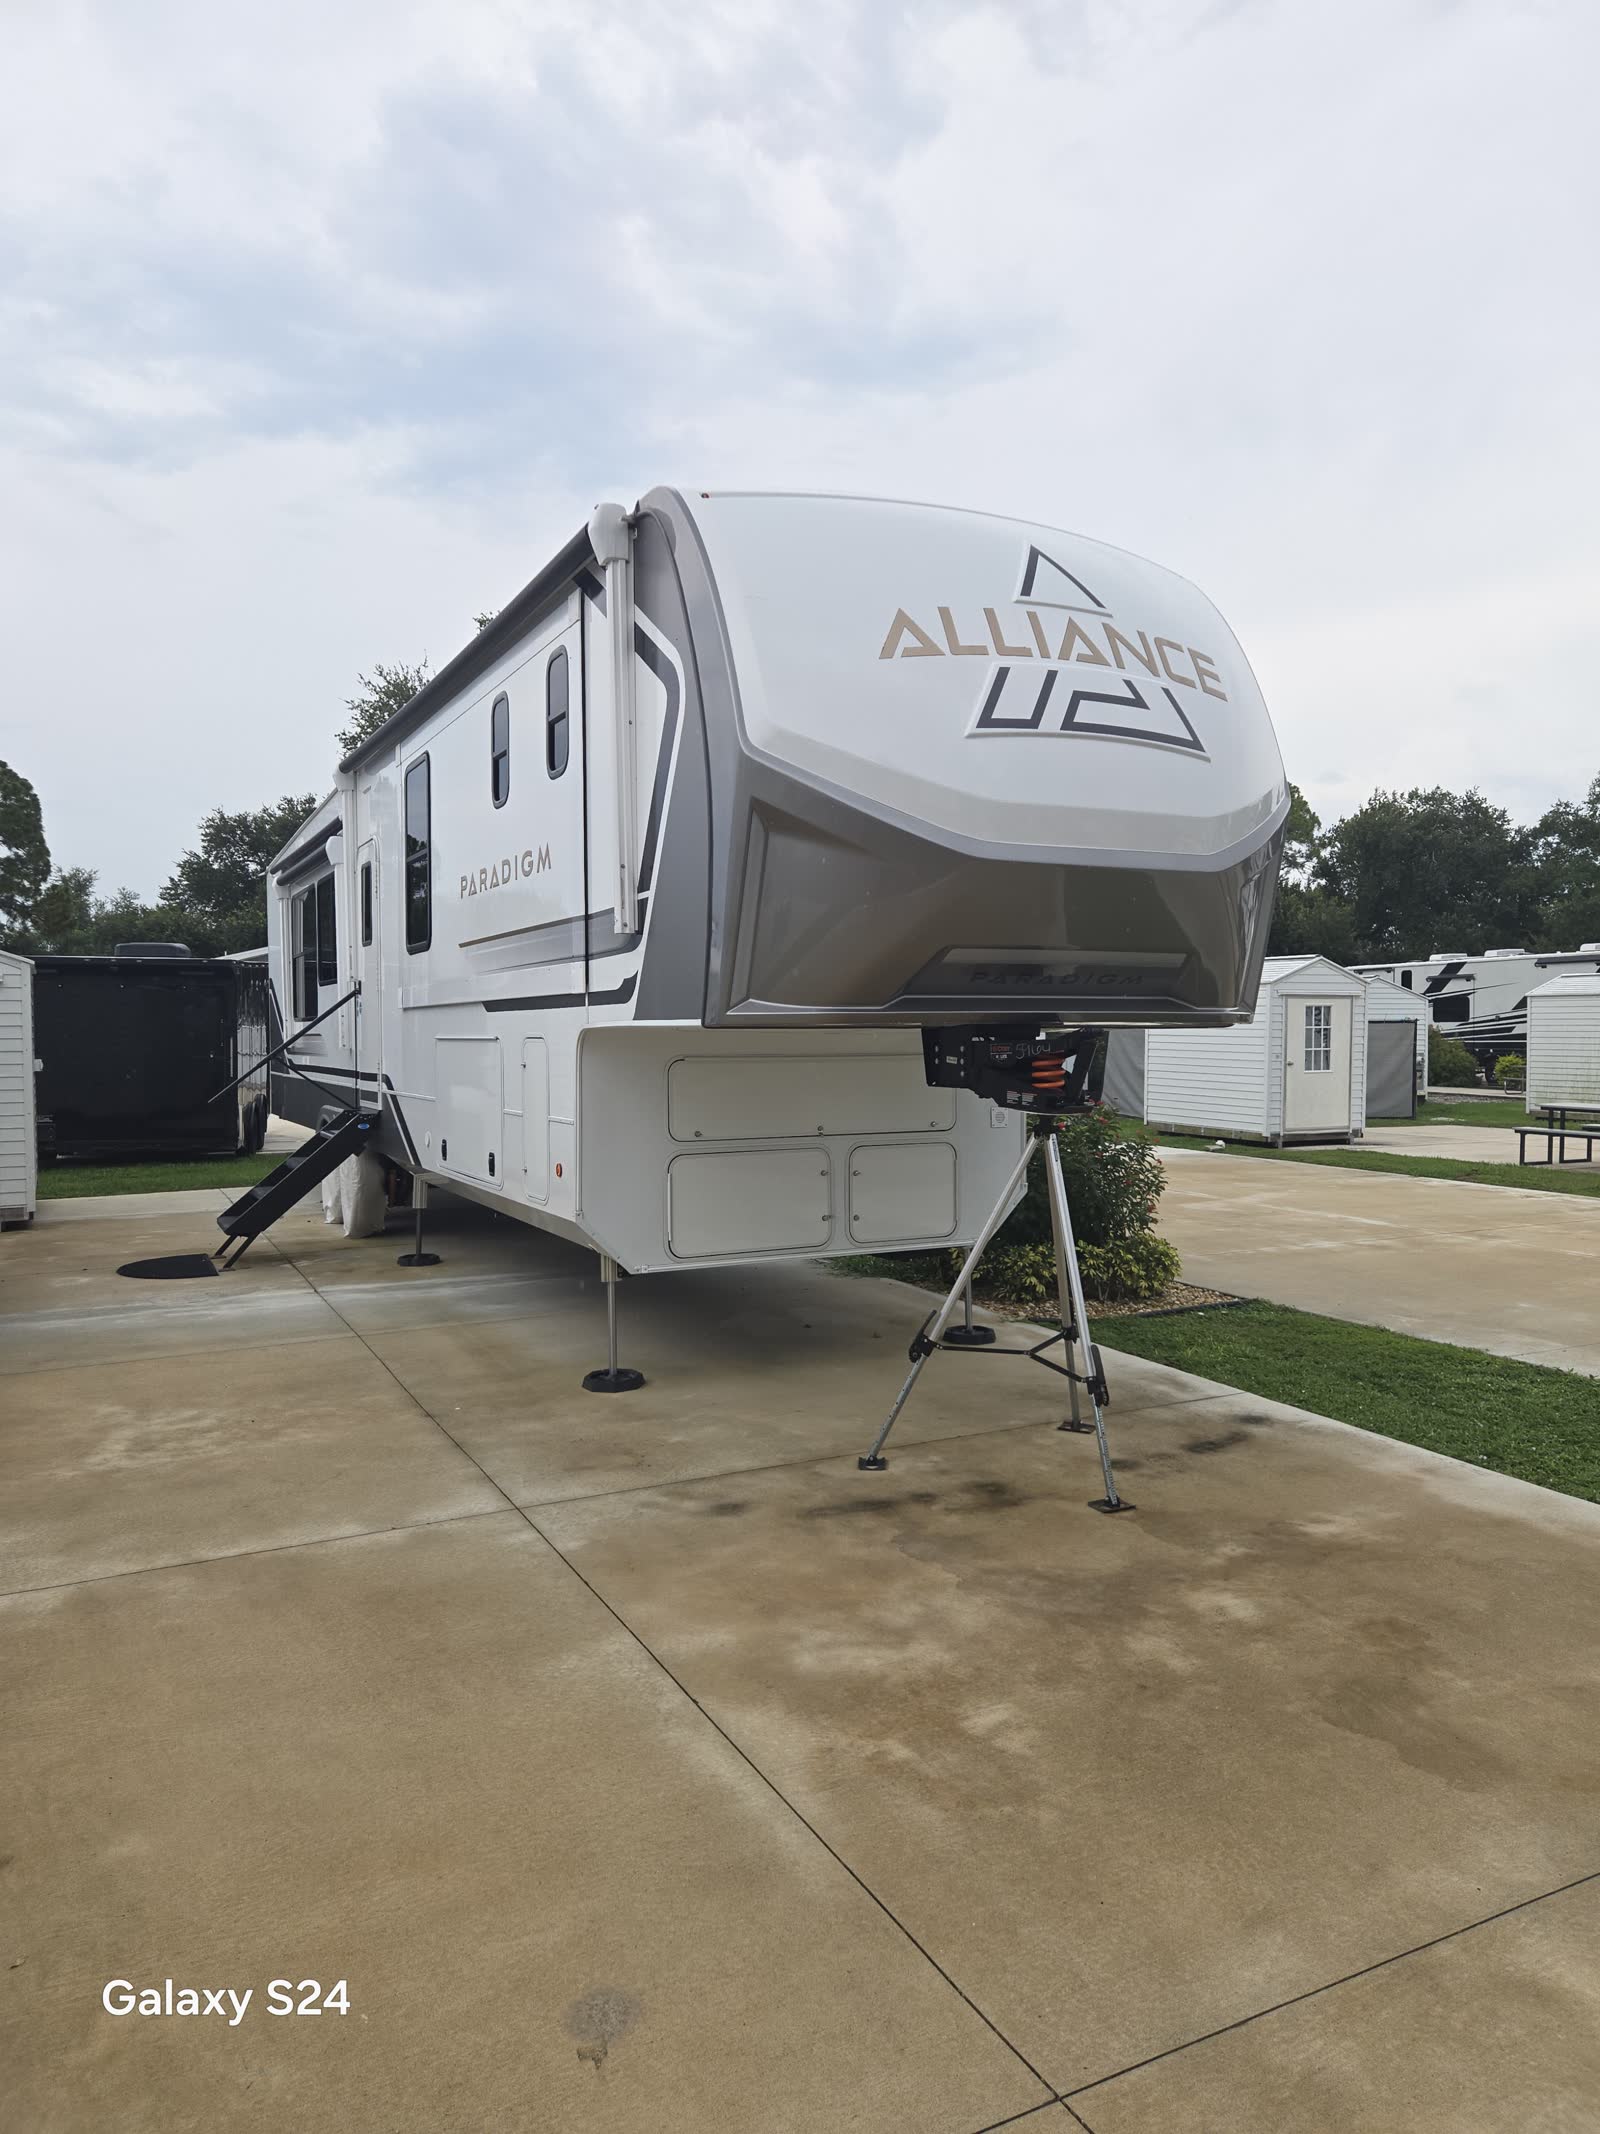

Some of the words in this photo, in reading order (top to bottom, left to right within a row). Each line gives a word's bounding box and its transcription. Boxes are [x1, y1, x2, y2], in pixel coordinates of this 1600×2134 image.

[878, 606, 1228, 702] ALLIANCE
[460, 842, 552, 899] PARADIGM
[968, 971, 1144, 985] PARADIGM
